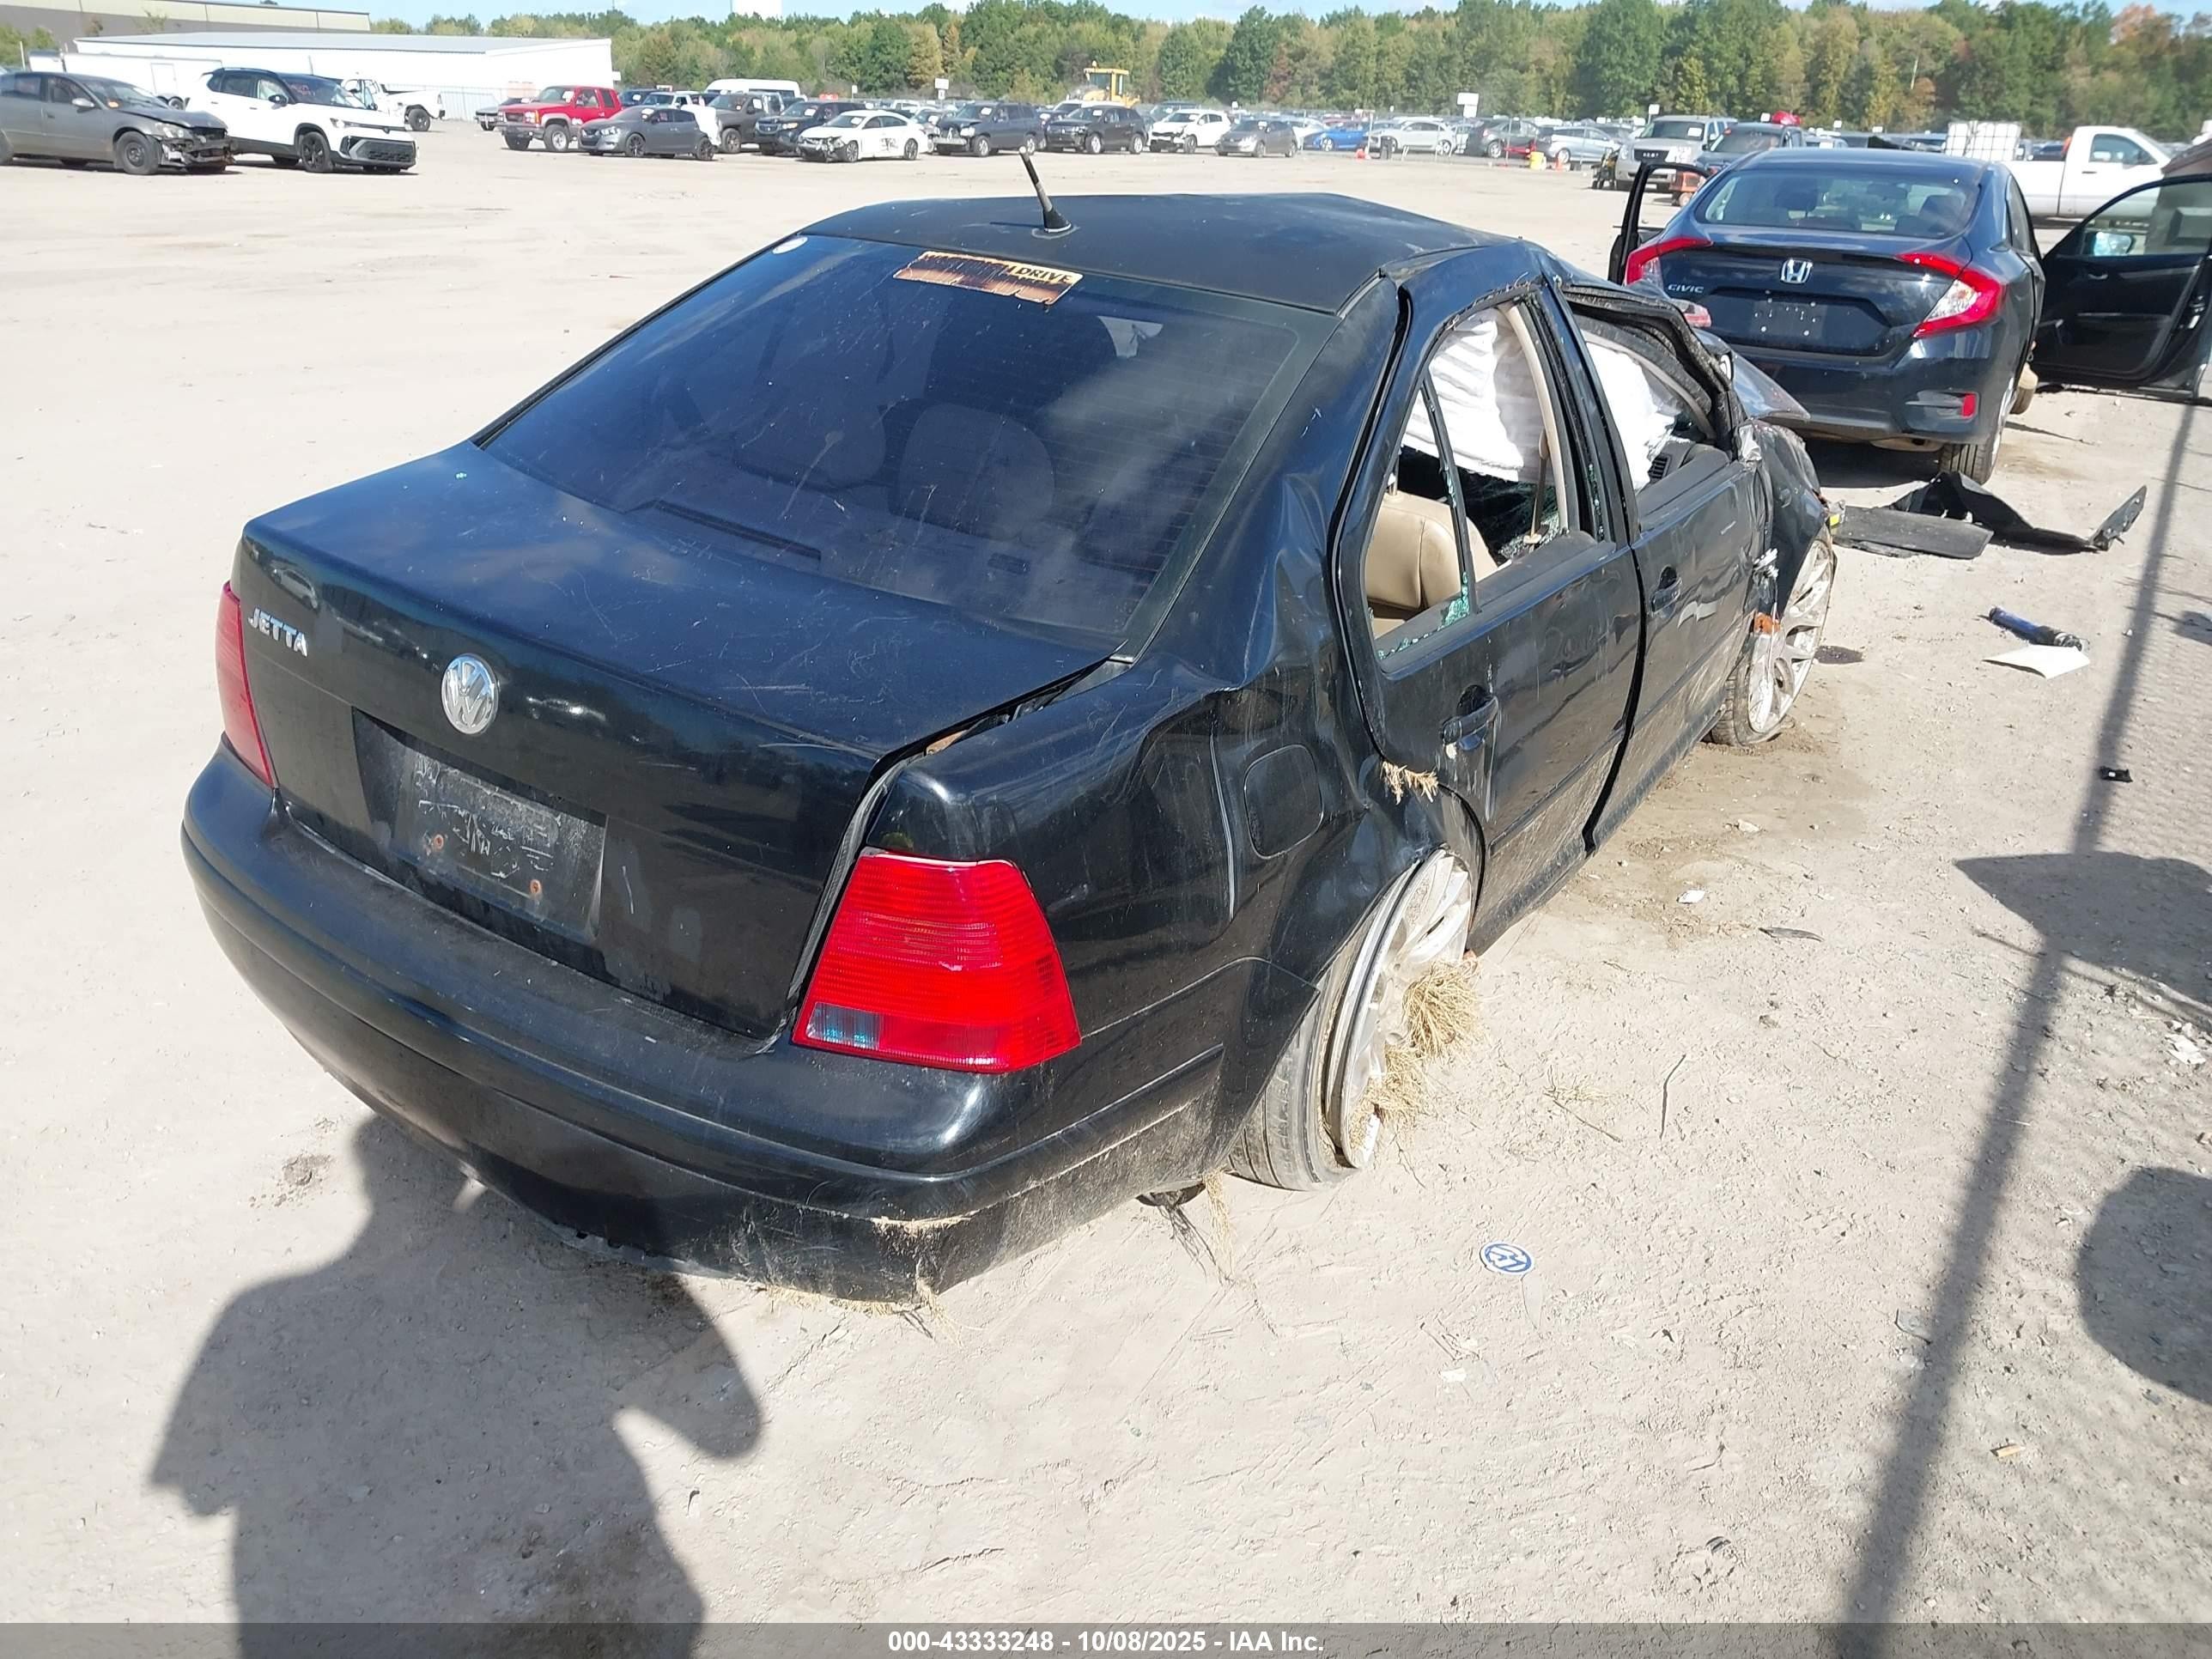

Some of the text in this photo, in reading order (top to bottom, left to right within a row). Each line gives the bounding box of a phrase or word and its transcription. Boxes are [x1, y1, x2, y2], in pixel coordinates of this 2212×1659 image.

[1015, 267, 1073, 283] DRIVE
[1668, 284, 1705, 294] CIVIC
[247, 607, 307, 657] JETTA
